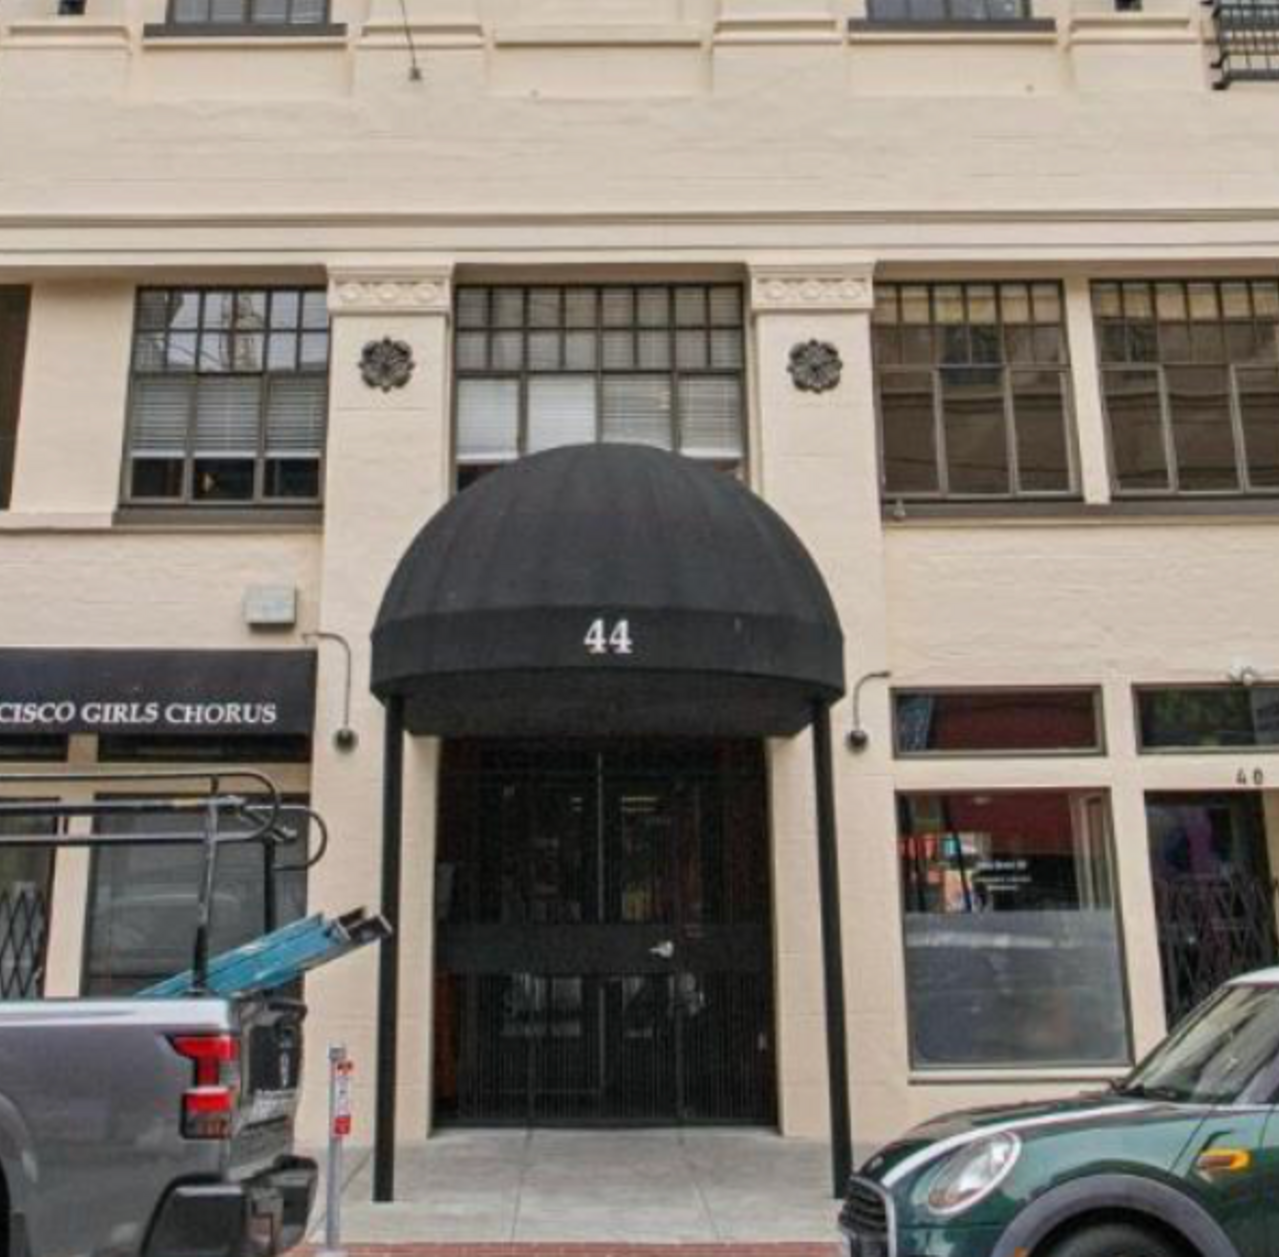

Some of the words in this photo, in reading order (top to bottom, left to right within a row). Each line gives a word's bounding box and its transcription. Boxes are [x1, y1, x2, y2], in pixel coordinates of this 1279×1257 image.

[584, 618, 633, 654] 44
[80, 701, 159, 724] GIRLS
[164, 702, 277, 725] CHORUS
[1235, 767, 1264, 785] 40
